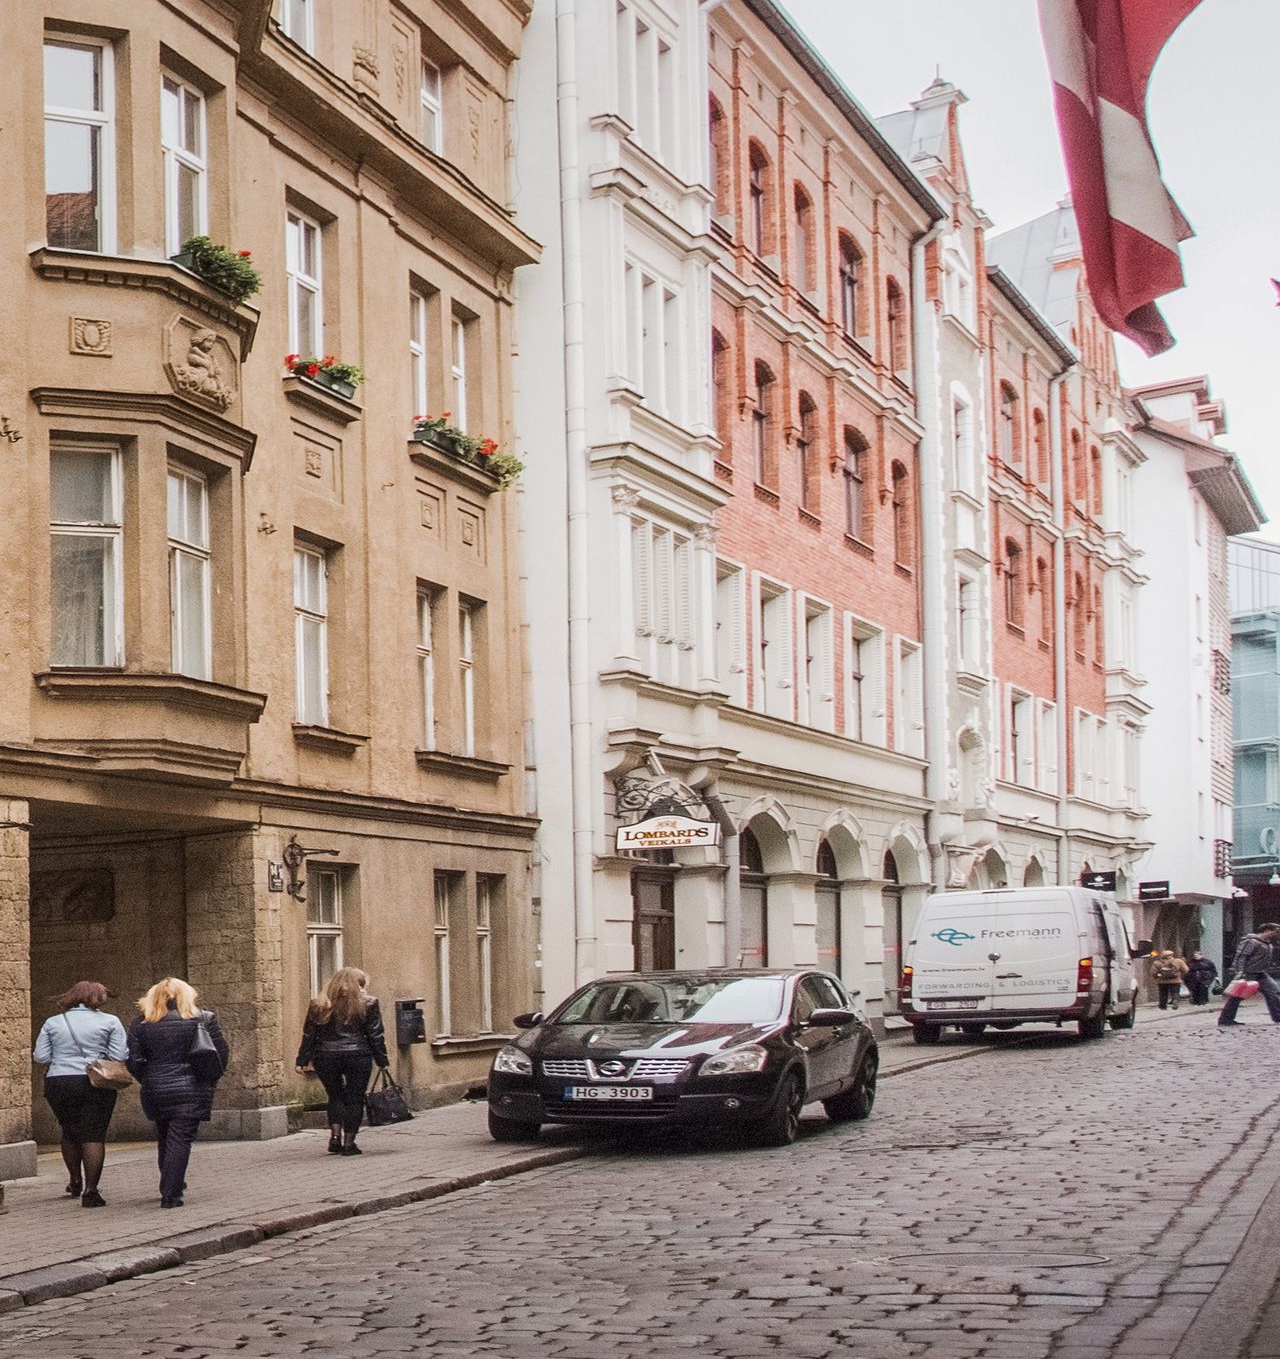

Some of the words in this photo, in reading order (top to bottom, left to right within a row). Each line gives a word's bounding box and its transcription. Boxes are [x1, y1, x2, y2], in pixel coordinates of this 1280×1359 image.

[624, 827, 709, 841] LOMBARDS
[639, 838, 692, 846] VEIKALS
[981, 927, 1061, 939] Freemann
[918, 981, 990, 990] FORWARDING
[1013, 978, 1071, 987] LOGISTICS
